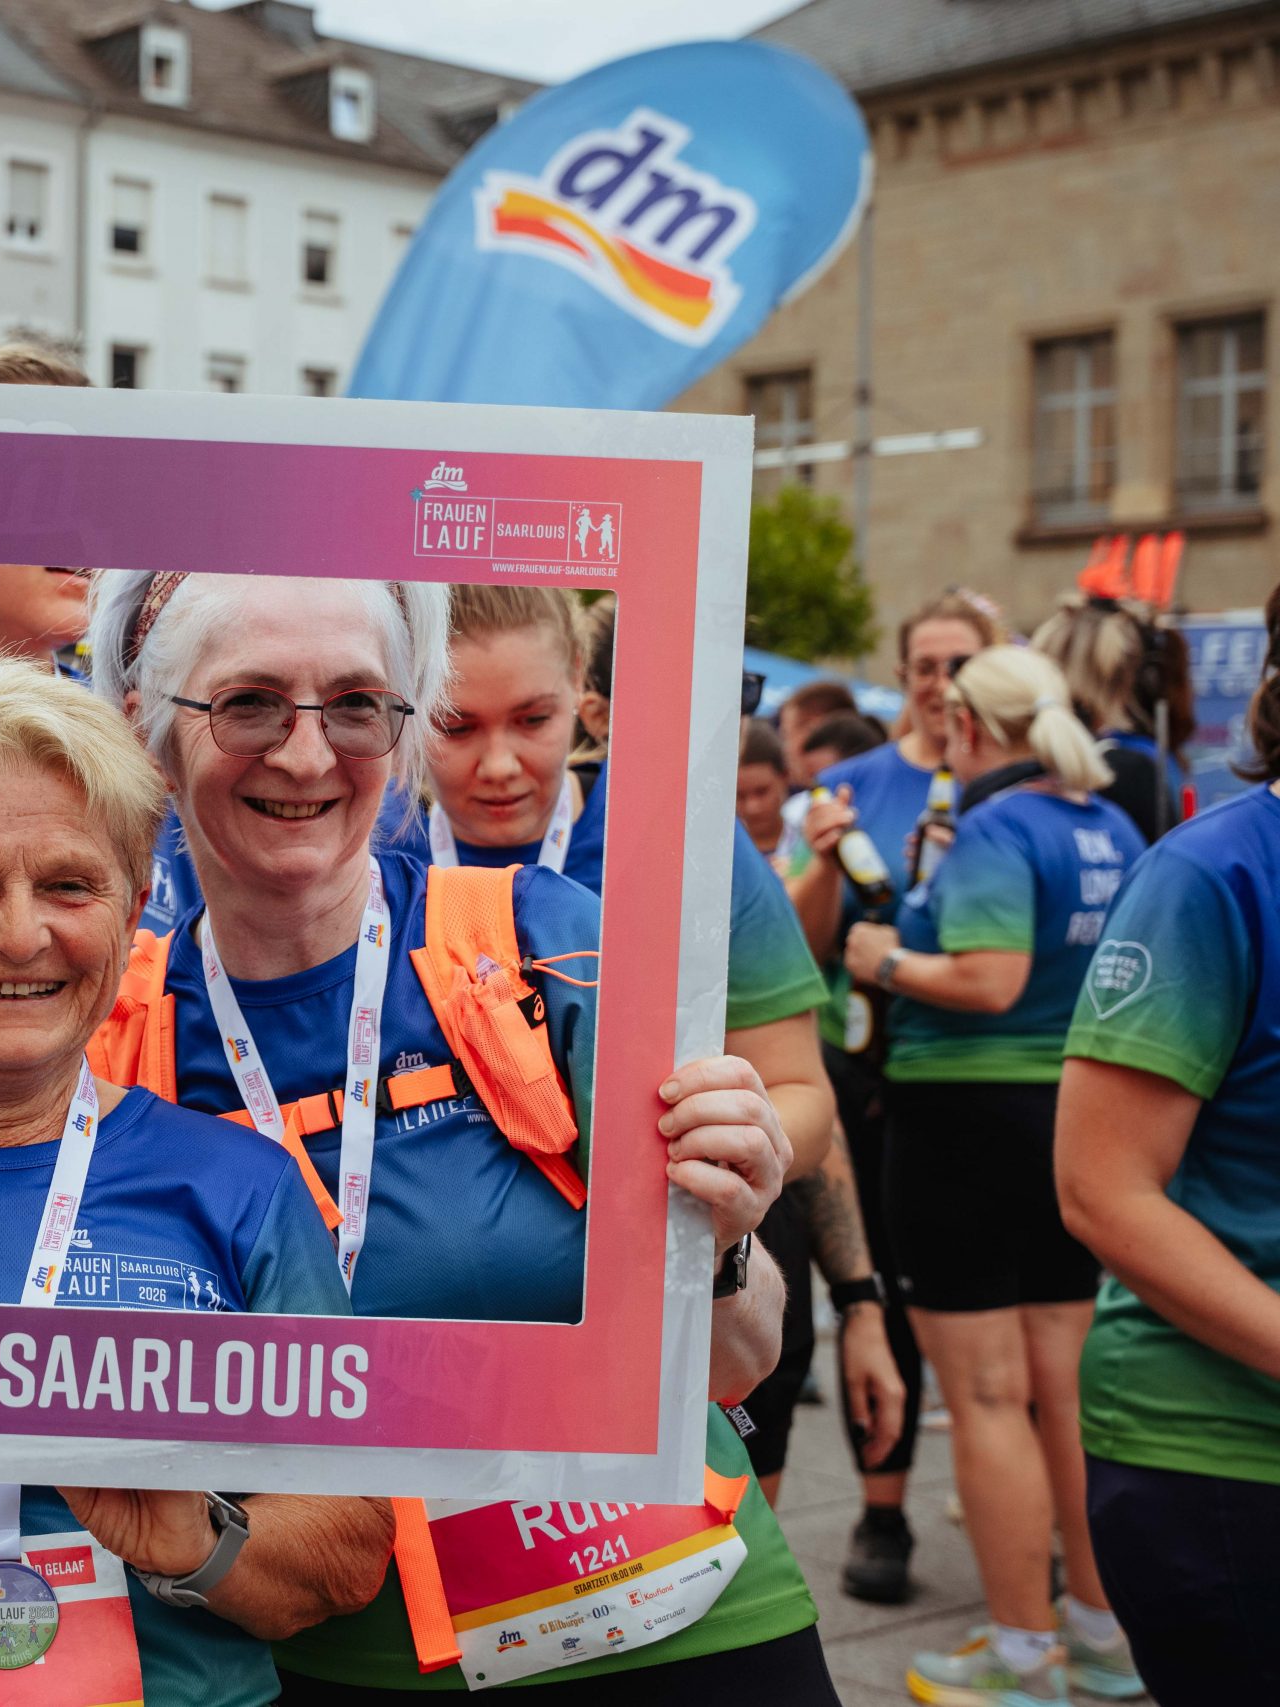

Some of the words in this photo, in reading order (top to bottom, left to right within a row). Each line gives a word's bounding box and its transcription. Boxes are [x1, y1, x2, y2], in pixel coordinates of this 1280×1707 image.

[556, 121, 737, 264] dm
[431, 461, 463, 481] dm
[423, 502, 486, 523] FRAUEN
[422, 525, 486, 551] LAUF
[496, 523, 565, 540] SAARLOUIS
[492, 563, 618, 577] WWW.FRAUENLAUF-SAARLOUIS.DE
[364, 924, 378, 943] dm
[235, 1038, 250, 1058] dm
[361, 1044, 370, 1063] LAUF
[396, 1050, 424, 1069] dm
[351, 1080, 364, 1102] dm
[72, 1113, 87, 1132] dm
[51, 1231, 62, 1249] LAUF
[63, 1257, 111, 1274] RAUEN
[121, 1260, 180, 1278] SAARLOUIS
[342, 1252, 351, 1274] dm
[31, 1266, 48, 1288] dm
[138, 1286, 167, 1303] 2026
[568, 1534, 632, 1576] 1241
[45, 1559, 86, 1577] GELAAF
[573, 1574, 611, 1595] STARTZEIT
[610, 1567, 629, 1584] 18:00
[628, 1562, 645, 1577] UHR
[643, 1583, 674, 1602] Kaufland
[28, 1605, 55, 1620] 2026
[499, 1629, 521, 1646] dm
